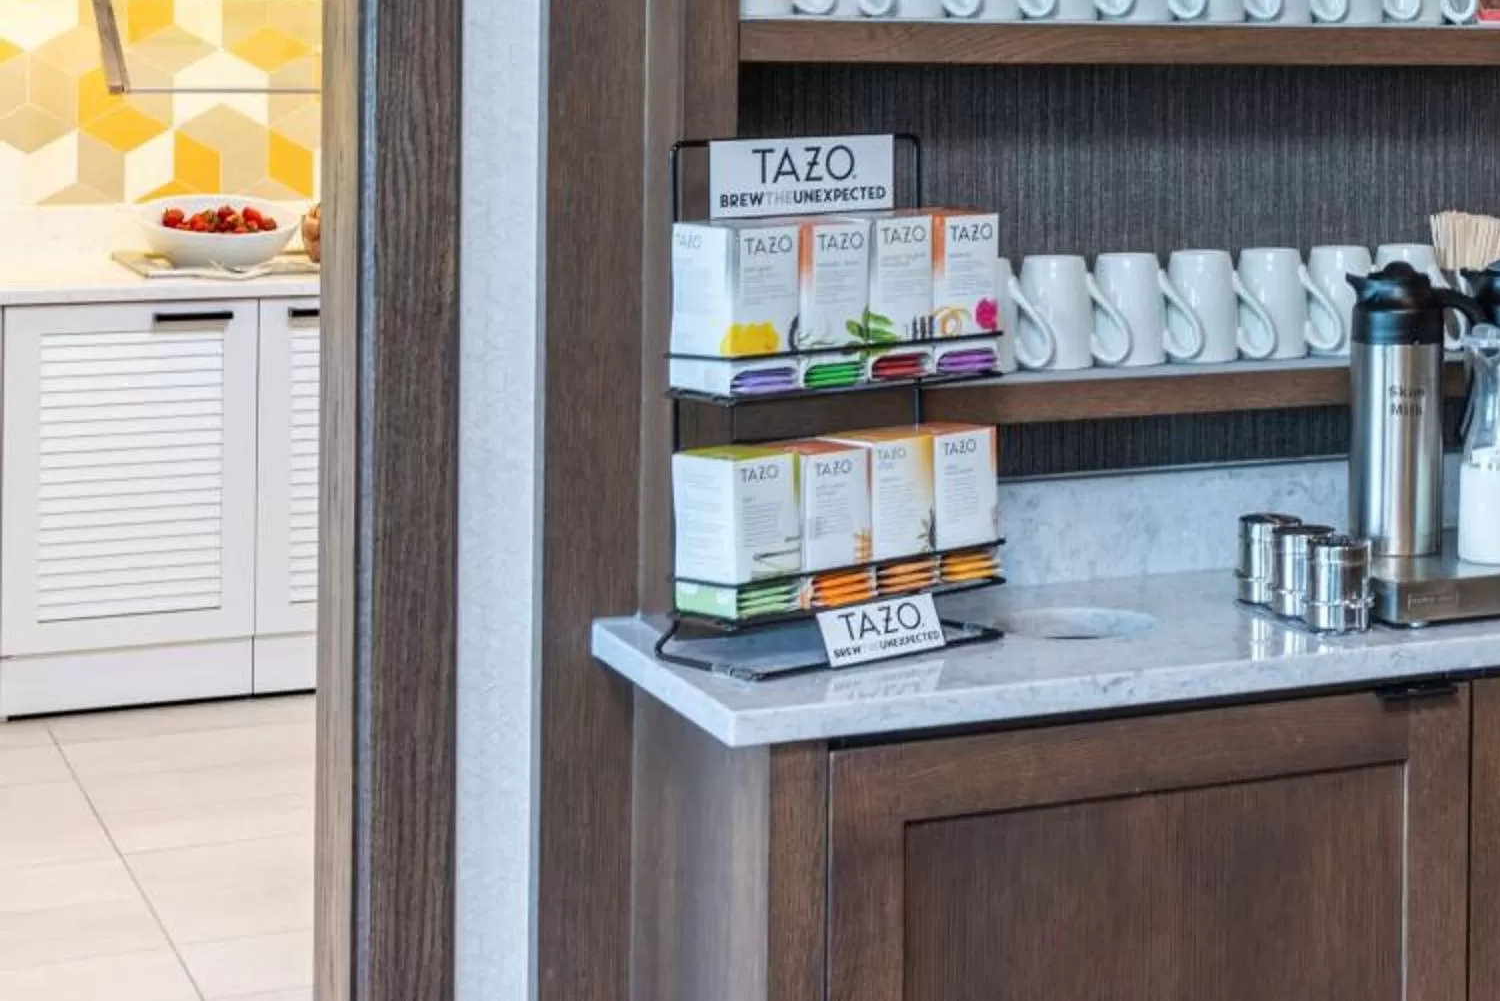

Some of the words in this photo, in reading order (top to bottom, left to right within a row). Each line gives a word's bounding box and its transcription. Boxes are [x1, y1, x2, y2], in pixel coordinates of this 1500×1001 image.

[752, 144, 855, 184] TAZO
[793, 186, 887, 204] UNEXPECTED
[816, 231, 865, 251] TAZO
[880, 225, 926, 245] TAZO
[950, 222, 993, 243] TAZO
[743, 234, 793, 255] TAZO
[943, 438, 976, 457] TAZO
[740, 463, 779, 483] TAZO
[815, 459, 852, 477] TAZO
[838, 602, 921, 641] TAZO
